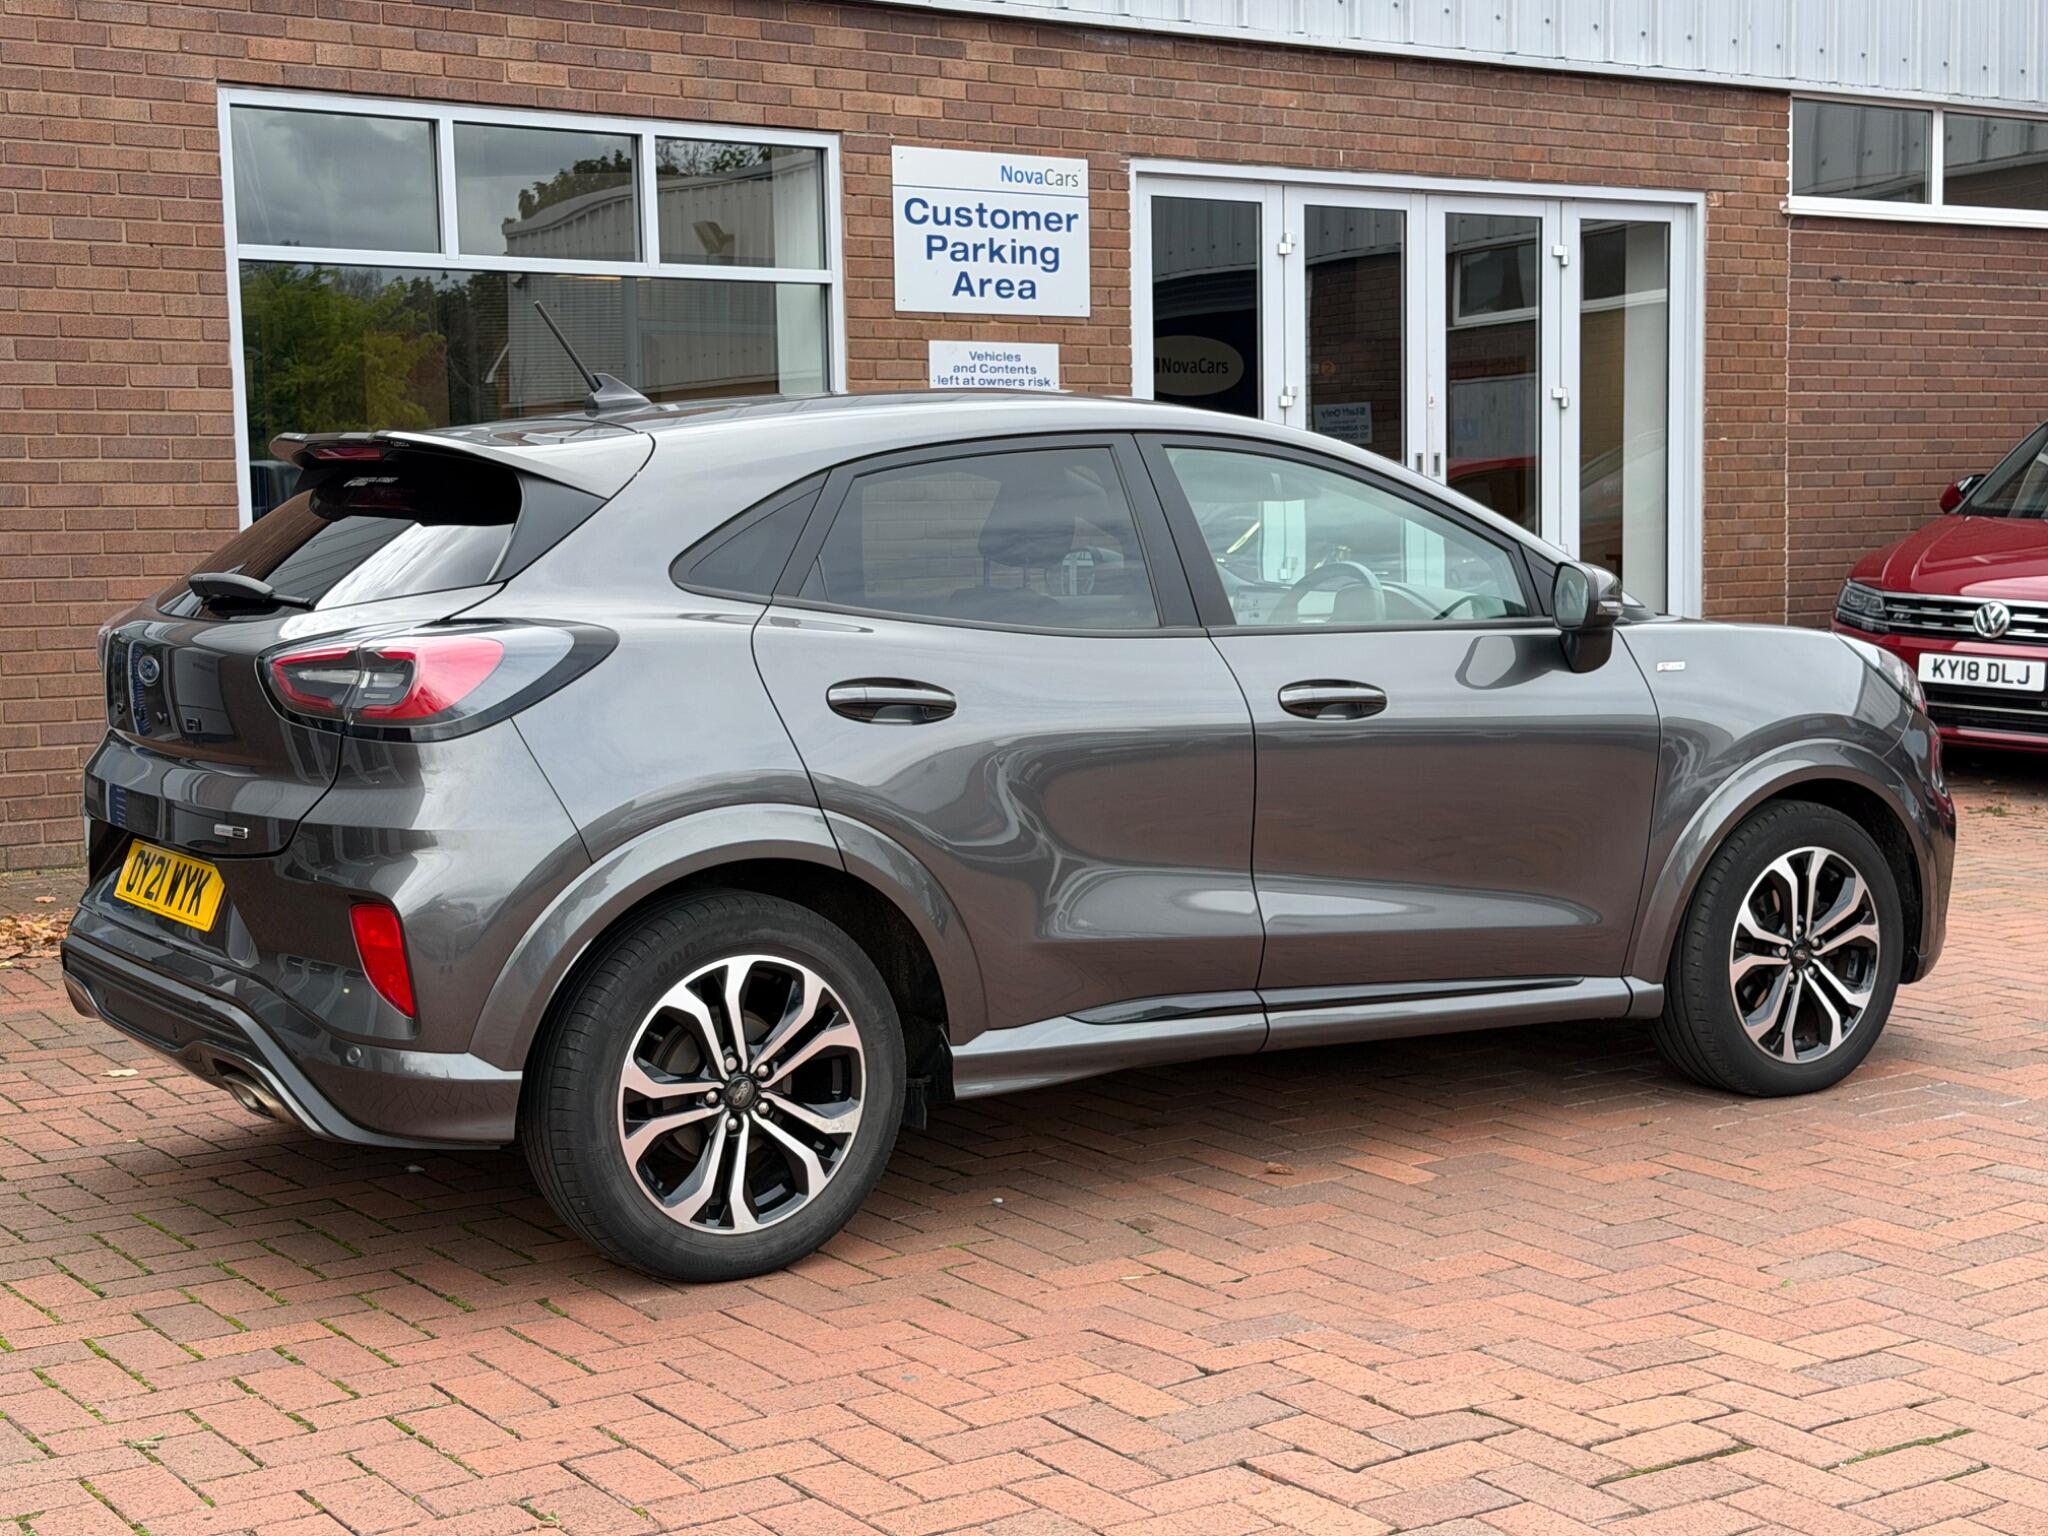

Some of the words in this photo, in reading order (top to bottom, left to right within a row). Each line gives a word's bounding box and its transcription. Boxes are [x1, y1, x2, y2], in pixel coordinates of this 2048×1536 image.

[1000, 164, 1079, 188] NovaCars
[904, 197, 1079, 233] Customer
[926, 234, 1060, 274] Parking
[952, 270, 1037, 300] Area
[952, 364, 976, 374] and
[979, 364, 1037, 375] Contents
[968, 351, 1022, 362] Vehicles
[937, 375, 959, 386] left
[962, 377, 975, 386] at
[978, 379, 1025, 387] owners
[1028, 377, 1052, 387] risk
[1931, 657, 1980, 682] KY18
[1986, 662, 2030, 685] DLJ
[163, 860, 213, 917] WYK
